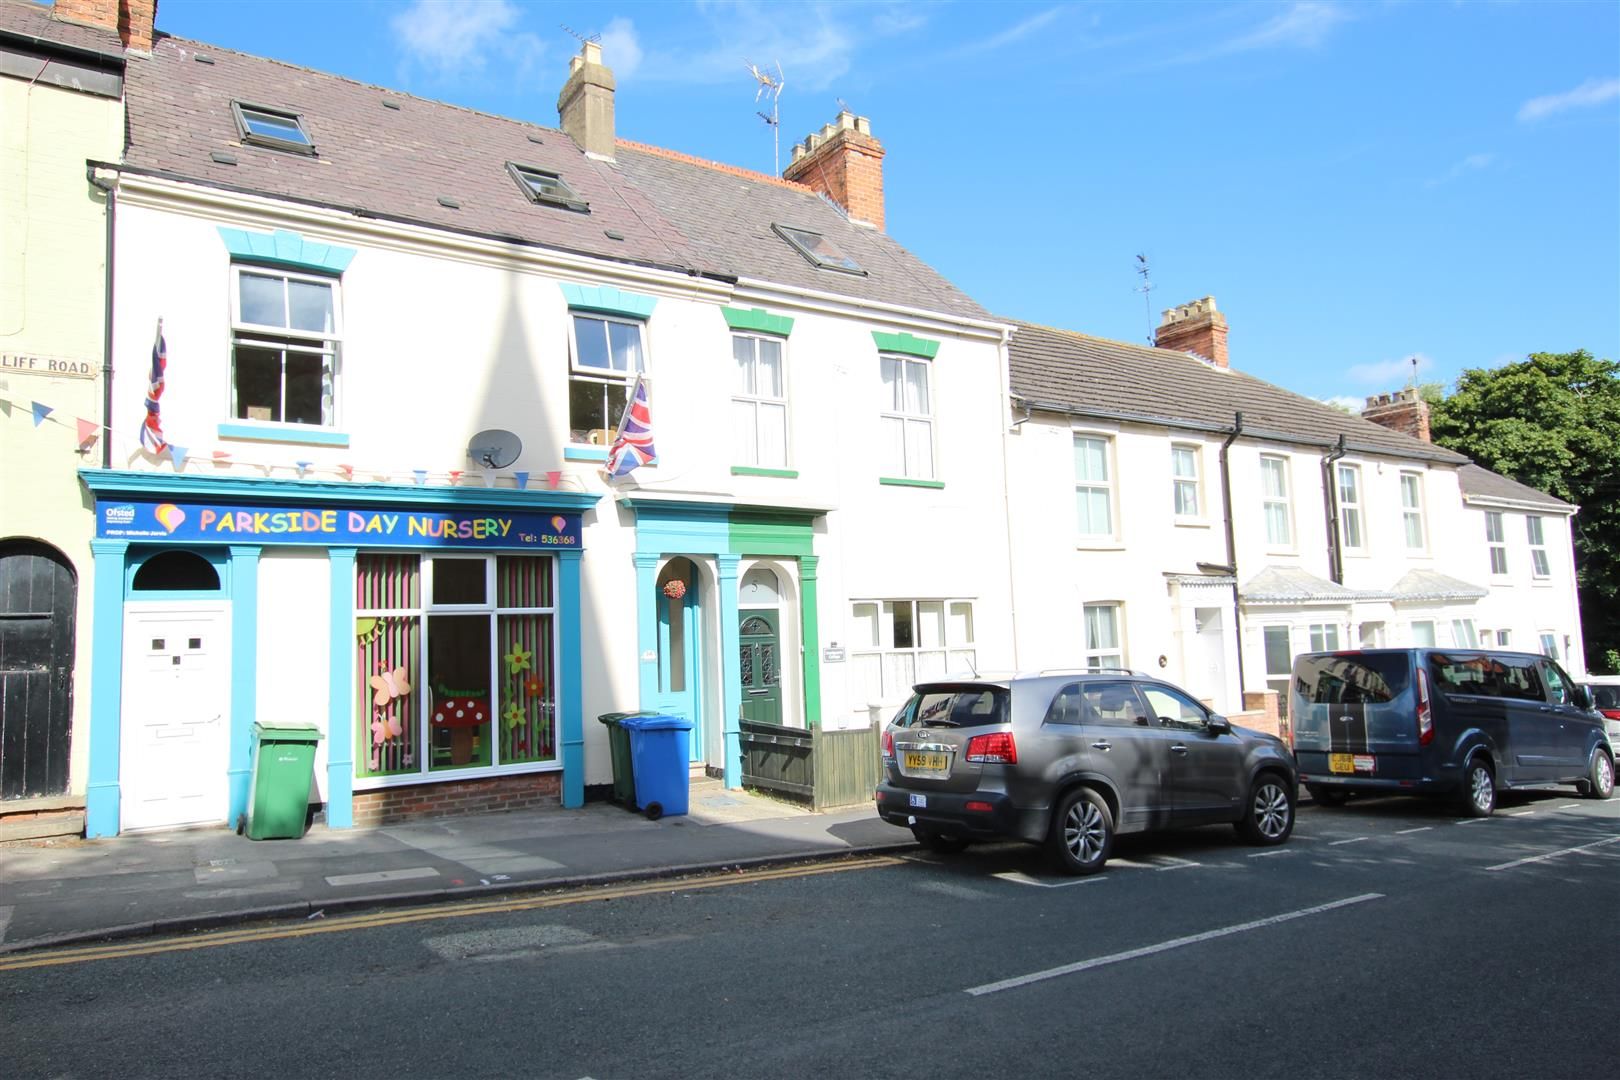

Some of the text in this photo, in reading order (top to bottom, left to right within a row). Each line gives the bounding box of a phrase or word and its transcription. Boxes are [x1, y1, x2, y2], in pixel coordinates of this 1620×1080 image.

[2, 355, 89, 374] LIFF ROAD
[105, 507, 135, 518] Ofsted
[200, 510, 512, 539] PARKSIDE DAY NURSERY
[518, 532, 575, 545] Tel: 536368
